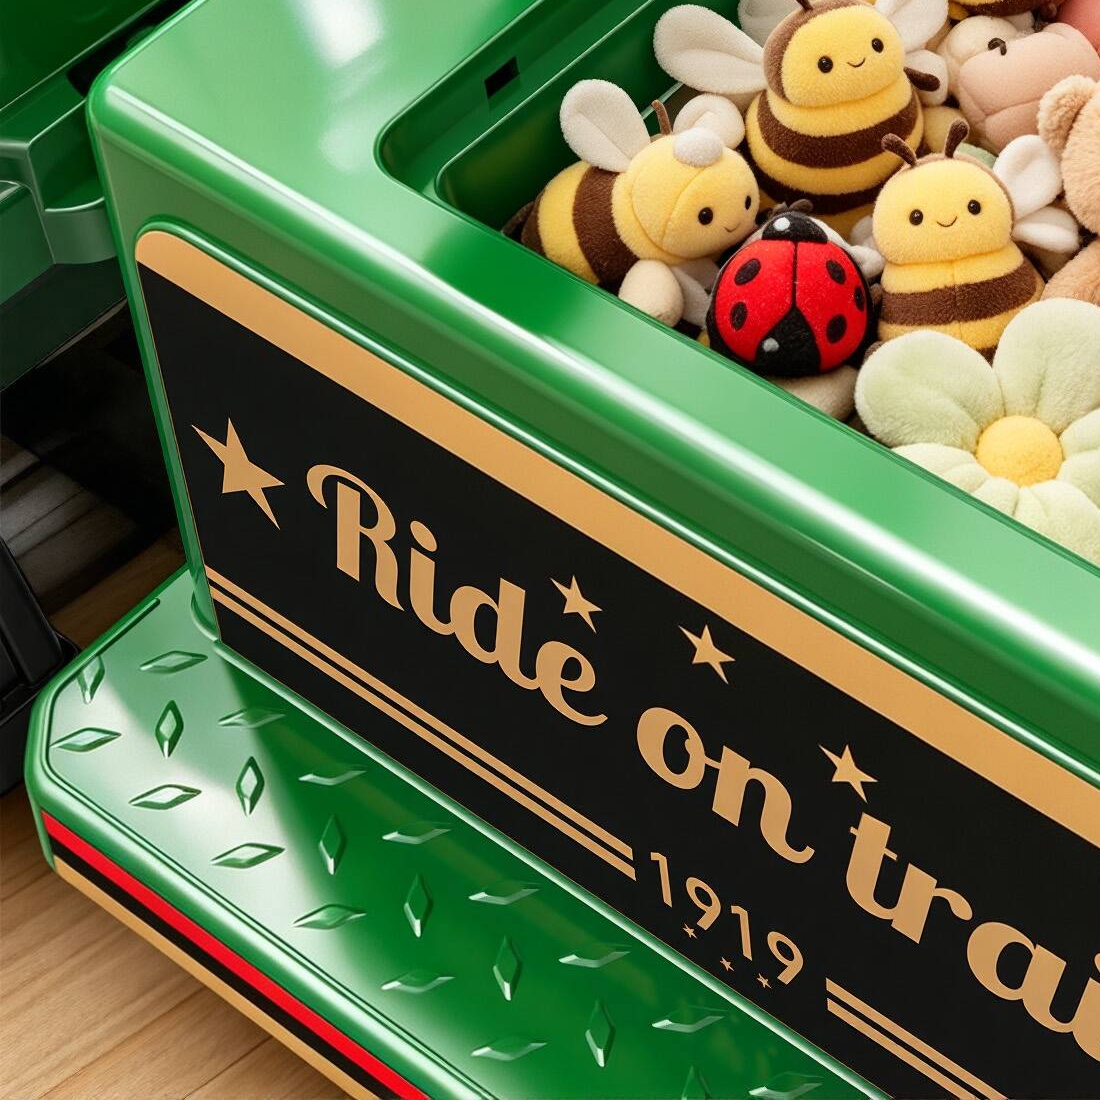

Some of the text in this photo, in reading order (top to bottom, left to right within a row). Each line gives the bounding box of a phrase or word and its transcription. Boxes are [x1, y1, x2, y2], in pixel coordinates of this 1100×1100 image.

[306, 464, 608, 726] Ride
[636, 707, 815, 864] on
[650, 851, 804, 985] 1919
